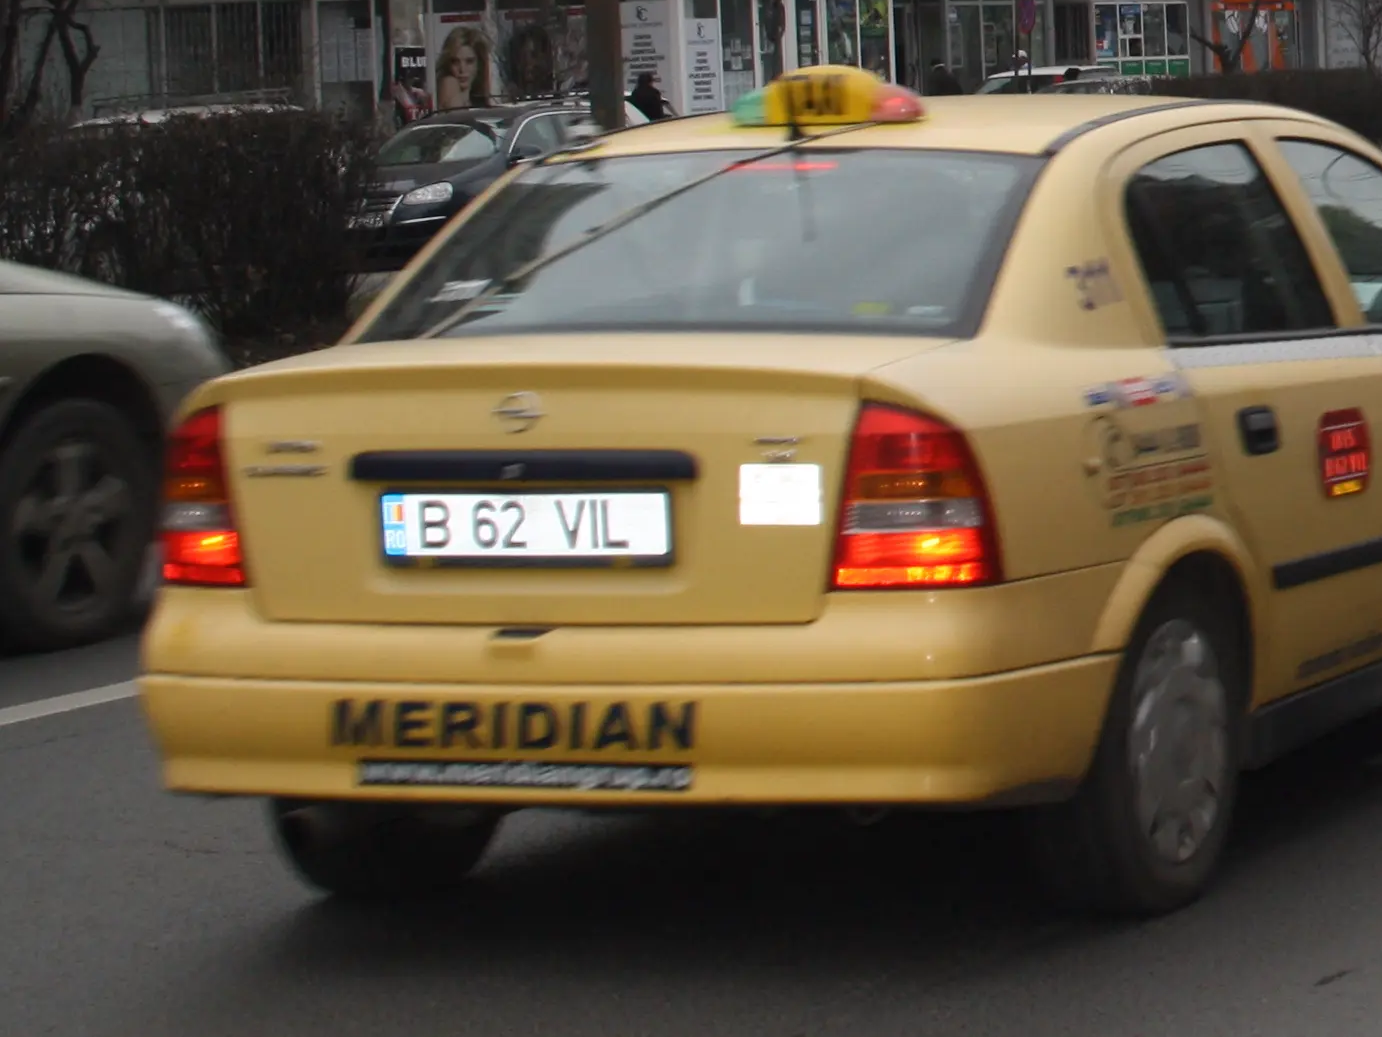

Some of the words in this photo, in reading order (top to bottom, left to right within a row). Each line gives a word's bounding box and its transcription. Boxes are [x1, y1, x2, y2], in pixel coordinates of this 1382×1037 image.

[418, 499, 451, 549] B
[472, 499, 528, 549] 62
[554, 499, 630, 549] VIL
[331, 698, 699, 751] MERIDIAN
